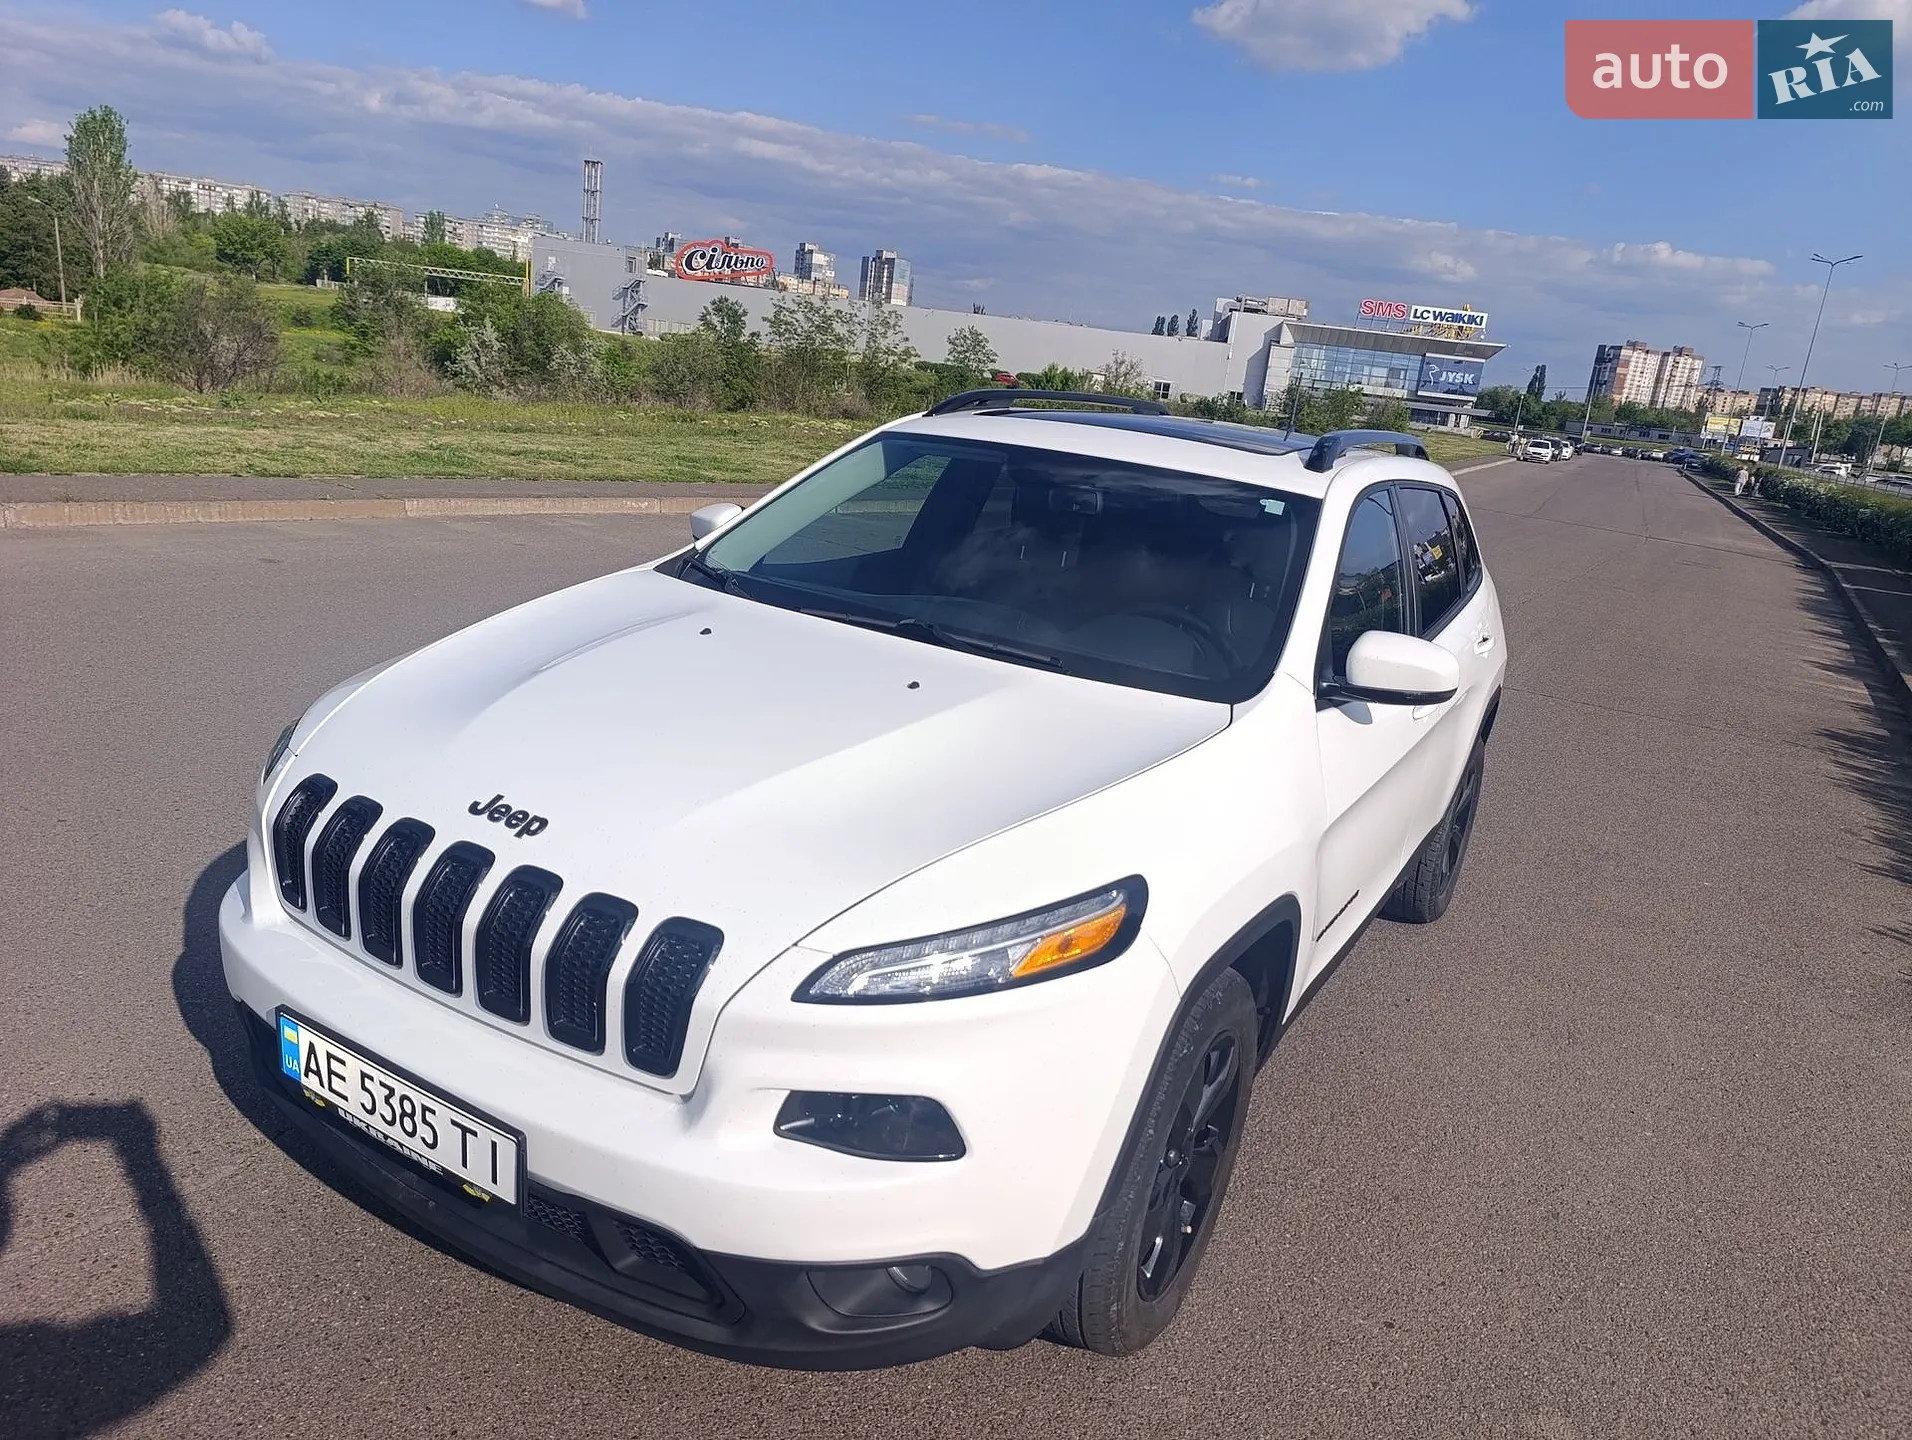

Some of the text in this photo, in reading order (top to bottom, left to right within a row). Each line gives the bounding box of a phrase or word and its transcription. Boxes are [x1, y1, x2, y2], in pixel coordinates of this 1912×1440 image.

[682, 246, 766, 273] Сільпо
[1361, 299, 1407, 319] SMS
[1412, 308, 1431, 320] LC
[1439, 370, 1475, 385] JYSK
[468, 793, 549, 839] Jeep
[285, 1053, 300, 1074] UA
[303, 1040, 349, 1103] AE
[359, 1069, 439, 1150] 5385
